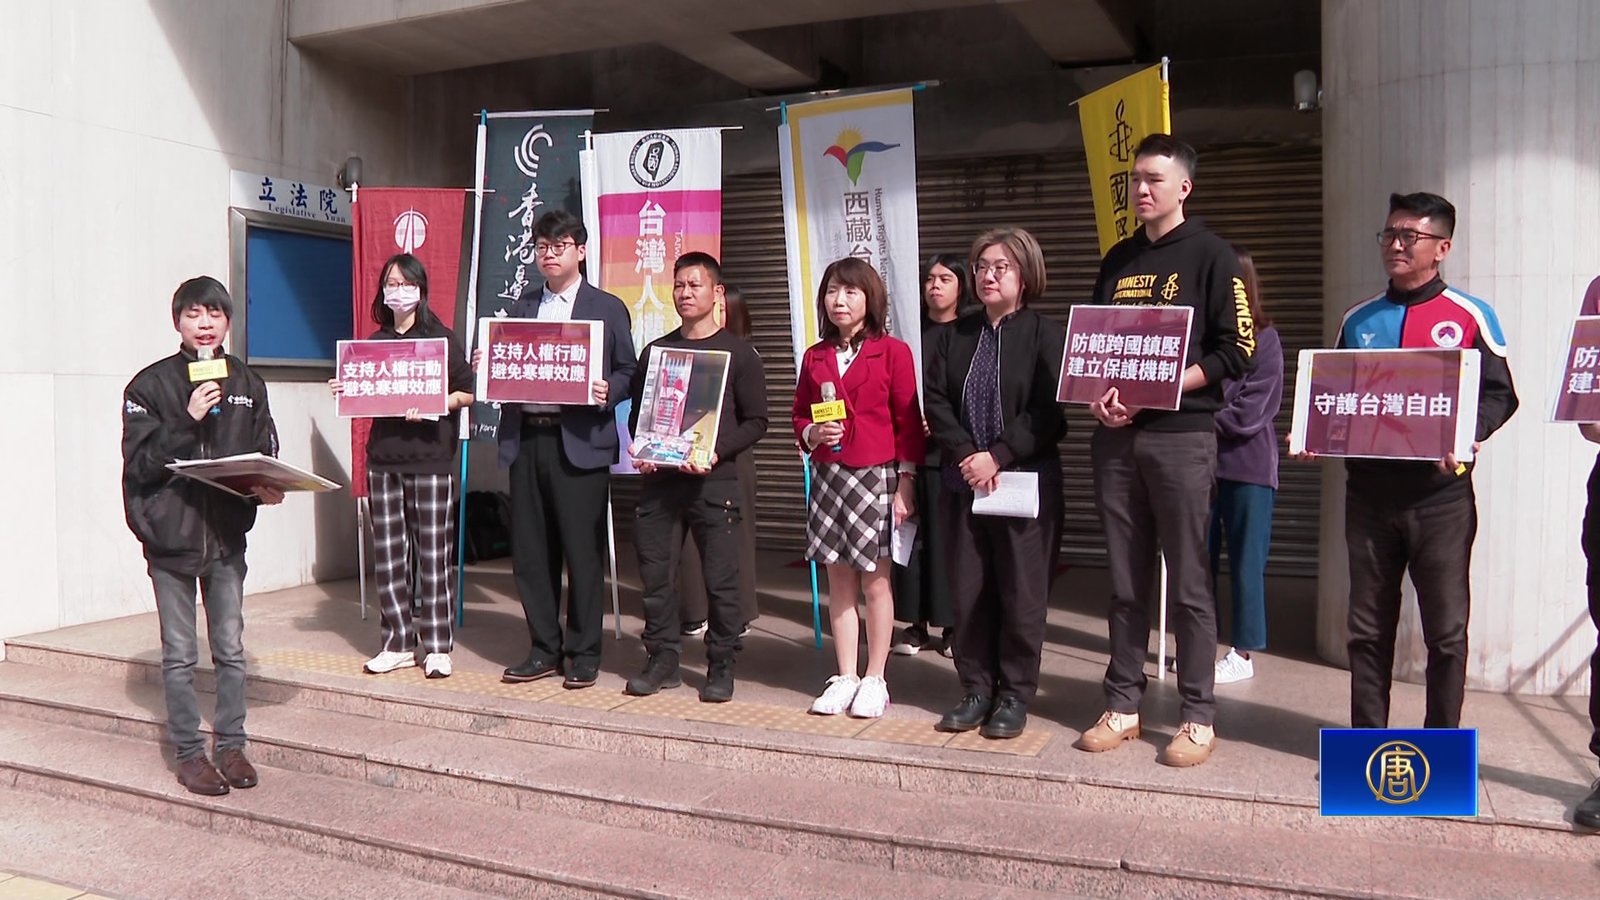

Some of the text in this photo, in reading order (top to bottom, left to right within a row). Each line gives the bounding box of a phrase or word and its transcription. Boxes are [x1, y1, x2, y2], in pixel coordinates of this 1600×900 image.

[258, 176, 352, 215] 立法院
[874, 188, 883, 222] Human
[268, 203, 346, 223] Legislative Yuan
[674, 229, 683, 261] TAIWA
[877, 223, 888, 255] Rights
[1115, 274, 1157, 291] AMNESTY
[1232, 276, 1256, 358] AMNESTY
[492, 342, 586, 362] 支持人權行動
[1070, 333, 1181, 357] 防範跨國鎮壓
[1573, 346, 1600, 368] 防
[343, 360, 442, 378] 支持人權行動
[491, 362, 586, 383] 避免寒蟬效應
[1067, 357, 1178, 383] 建立保護機制
[342, 378, 442, 396] 避免寒蟬效應
[1314, 392, 1452, 417] 守護台灣自由
